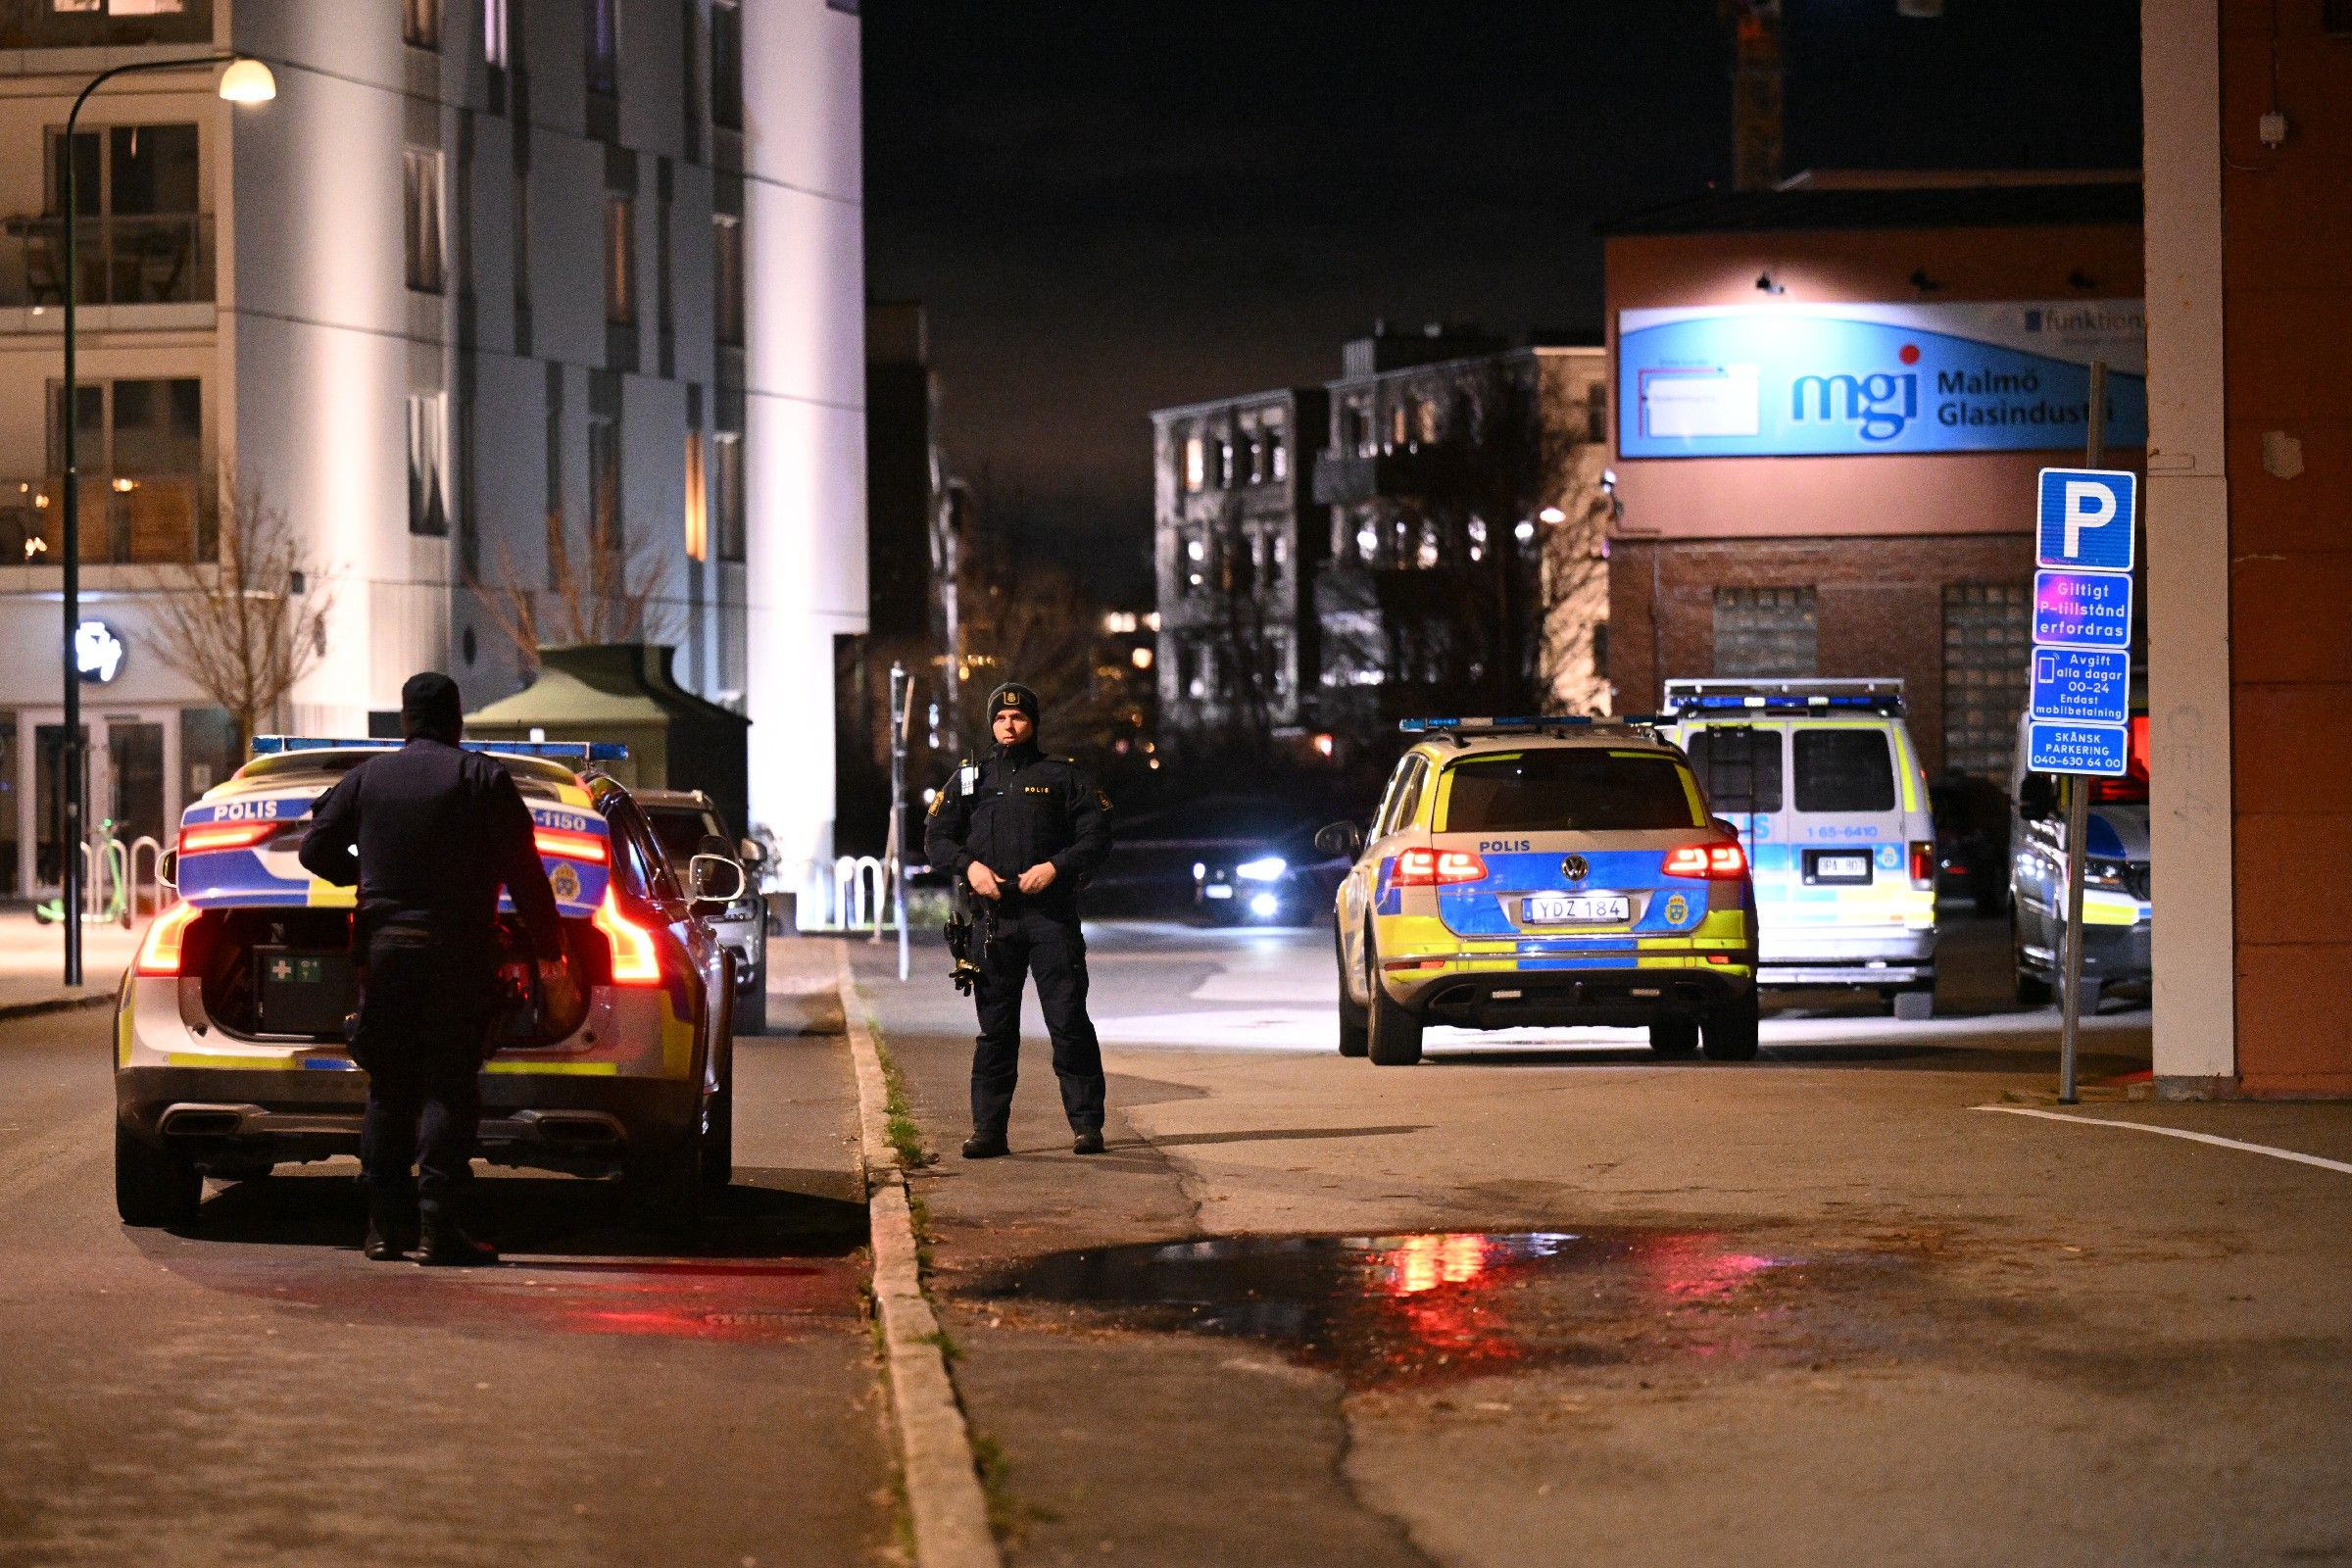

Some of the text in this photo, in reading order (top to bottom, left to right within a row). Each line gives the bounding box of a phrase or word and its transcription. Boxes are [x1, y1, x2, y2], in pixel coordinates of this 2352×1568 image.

[1937, 368, 2038, 395] Malmö
[1792, 344, 1921, 441] mgi
[1937, 399, 2113, 426] Glasindusti
[2064, 481, 2116, 558] P
[2057, 582, 2109, 601] Giltigt
[2039, 600, 2126, 617] P-tillstånd
[2039, 620, 2124, 637] erfordras
[2070, 654, 2111, 667] Avgift
[2056, 668, 2123, 682] alla dagar
[2068, 681, 2110, 694] 00-24
[2060, 694, 2099, 705] Endast
[2035, 706, 2122, 720] mobilbetalning
[2055, 731, 2101, 744] SKÅNSK
[2045, 744, 2110, 756] PARKERING
[2034, 755, 2122, 768] 040-630 64 00
[213, 802, 278, 822] POLIS
[1479, 840, 1531, 852] POLIS
[1540, 901, 1621, 917] YDZ 184
